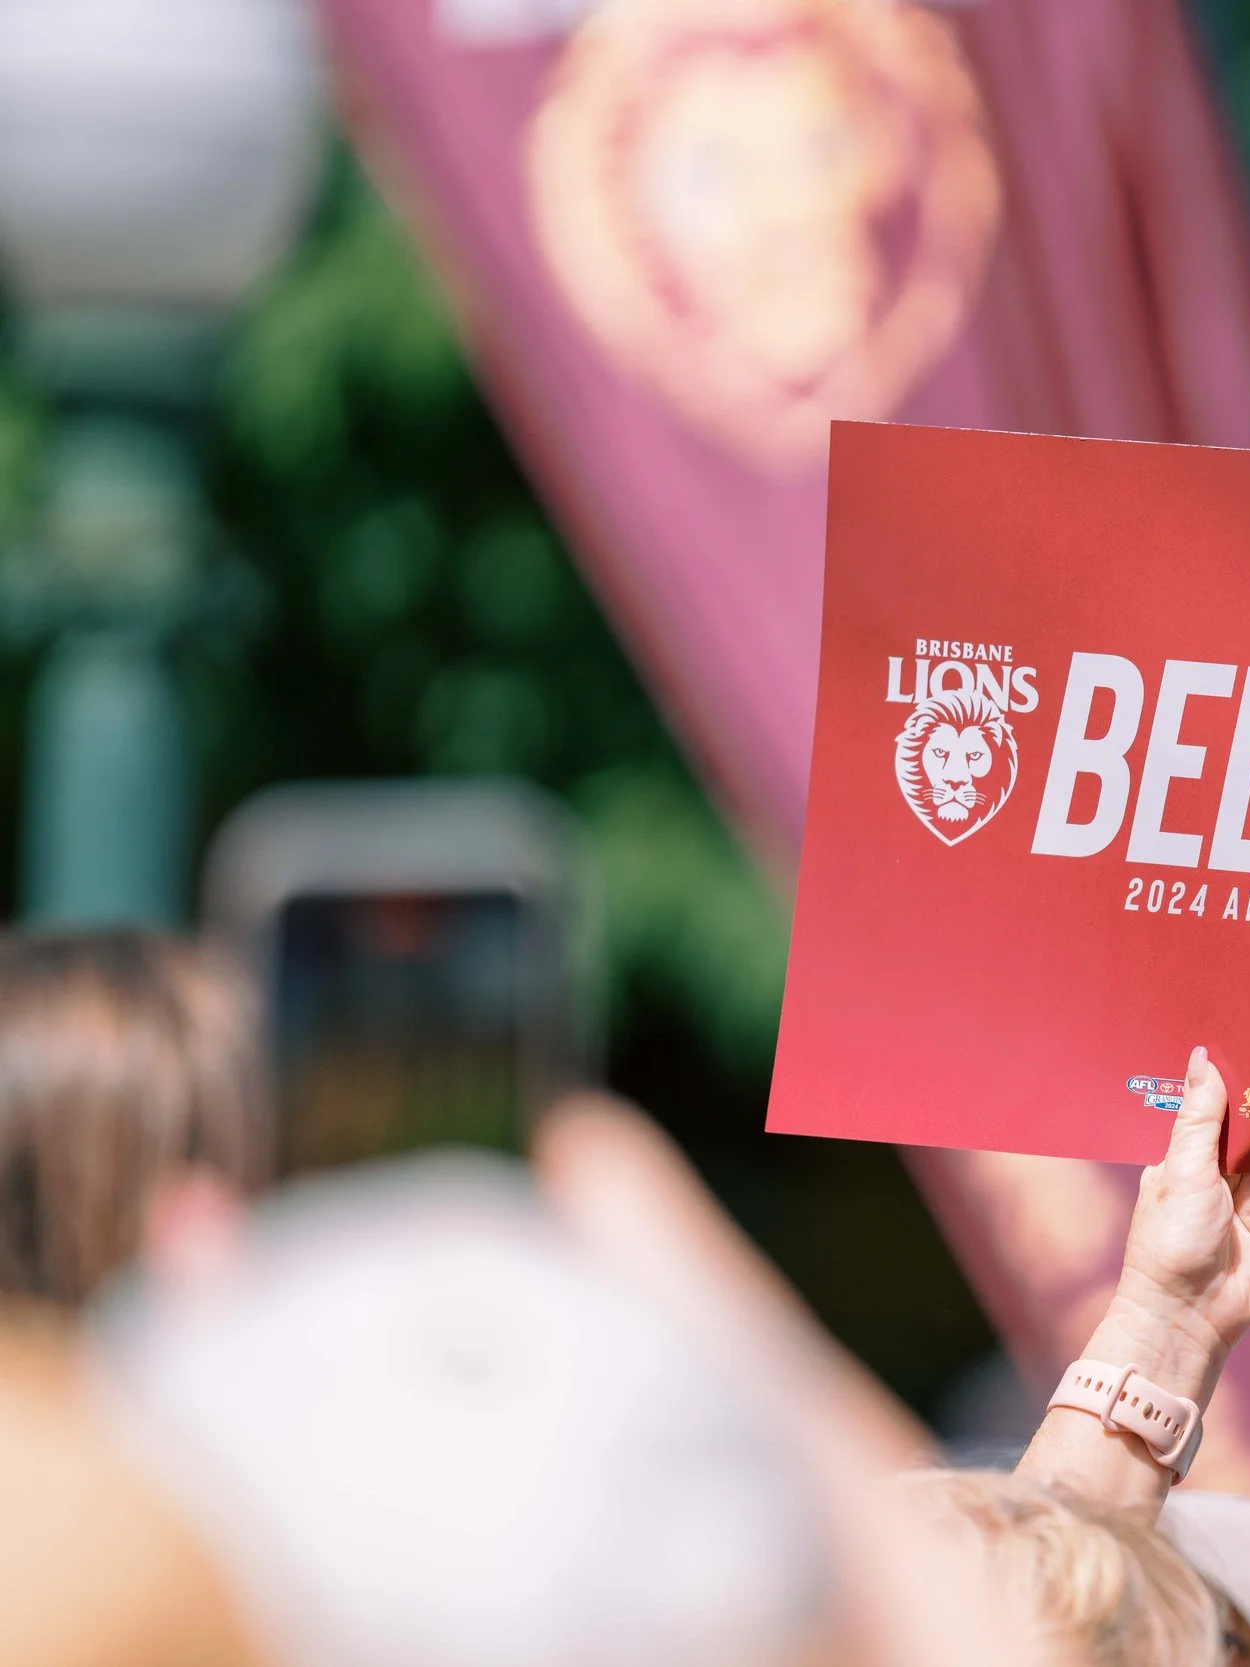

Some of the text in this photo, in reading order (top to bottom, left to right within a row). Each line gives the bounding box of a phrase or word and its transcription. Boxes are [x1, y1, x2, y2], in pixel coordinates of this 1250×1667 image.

[915, 638, 1014, 663] BRISBANE
[884, 656, 1040, 713] LIONS
[1125, 878, 1208, 917] 2024
[1130, 1079, 1155, 1091] AFL
